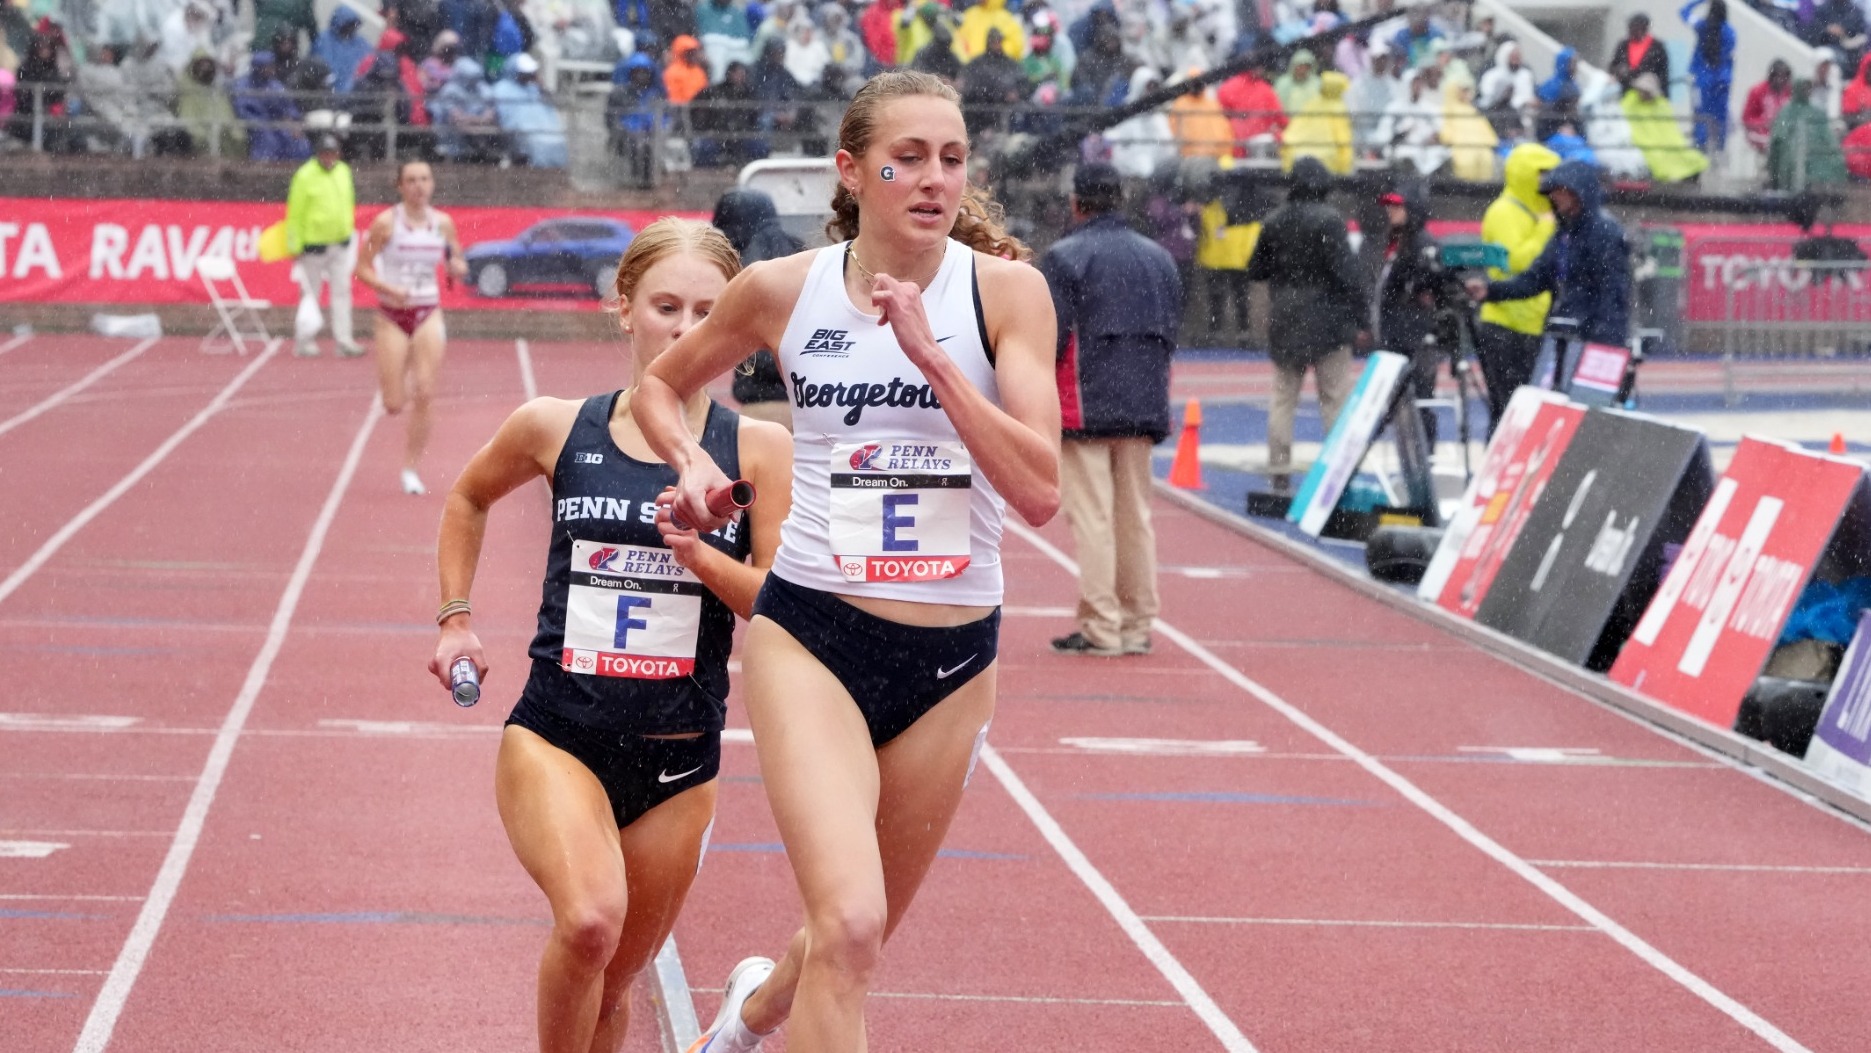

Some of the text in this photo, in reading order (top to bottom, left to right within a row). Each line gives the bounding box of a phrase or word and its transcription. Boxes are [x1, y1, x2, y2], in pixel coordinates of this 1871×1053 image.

[880, 165, 896, 181] G
[811, 329, 849, 340] BIG
[803, 340, 856, 350] EAST
[890, 445, 938, 457] PENN
[887, 459, 951, 470] RELAYS
[852, 477, 909, 487] Dream On.
[557, 496, 631, 522] PENN
[882, 494, 918, 551] E
[626, 550, 672, 563] PENN
[623, 562, 685, 576] RELAYS
[871, 560, 956, 577] TOYOTA
[590, 576, 642, 590] Dream On.
[613, 594, 652, 650] F
[601, 656, 680, 676] TOYOTA
